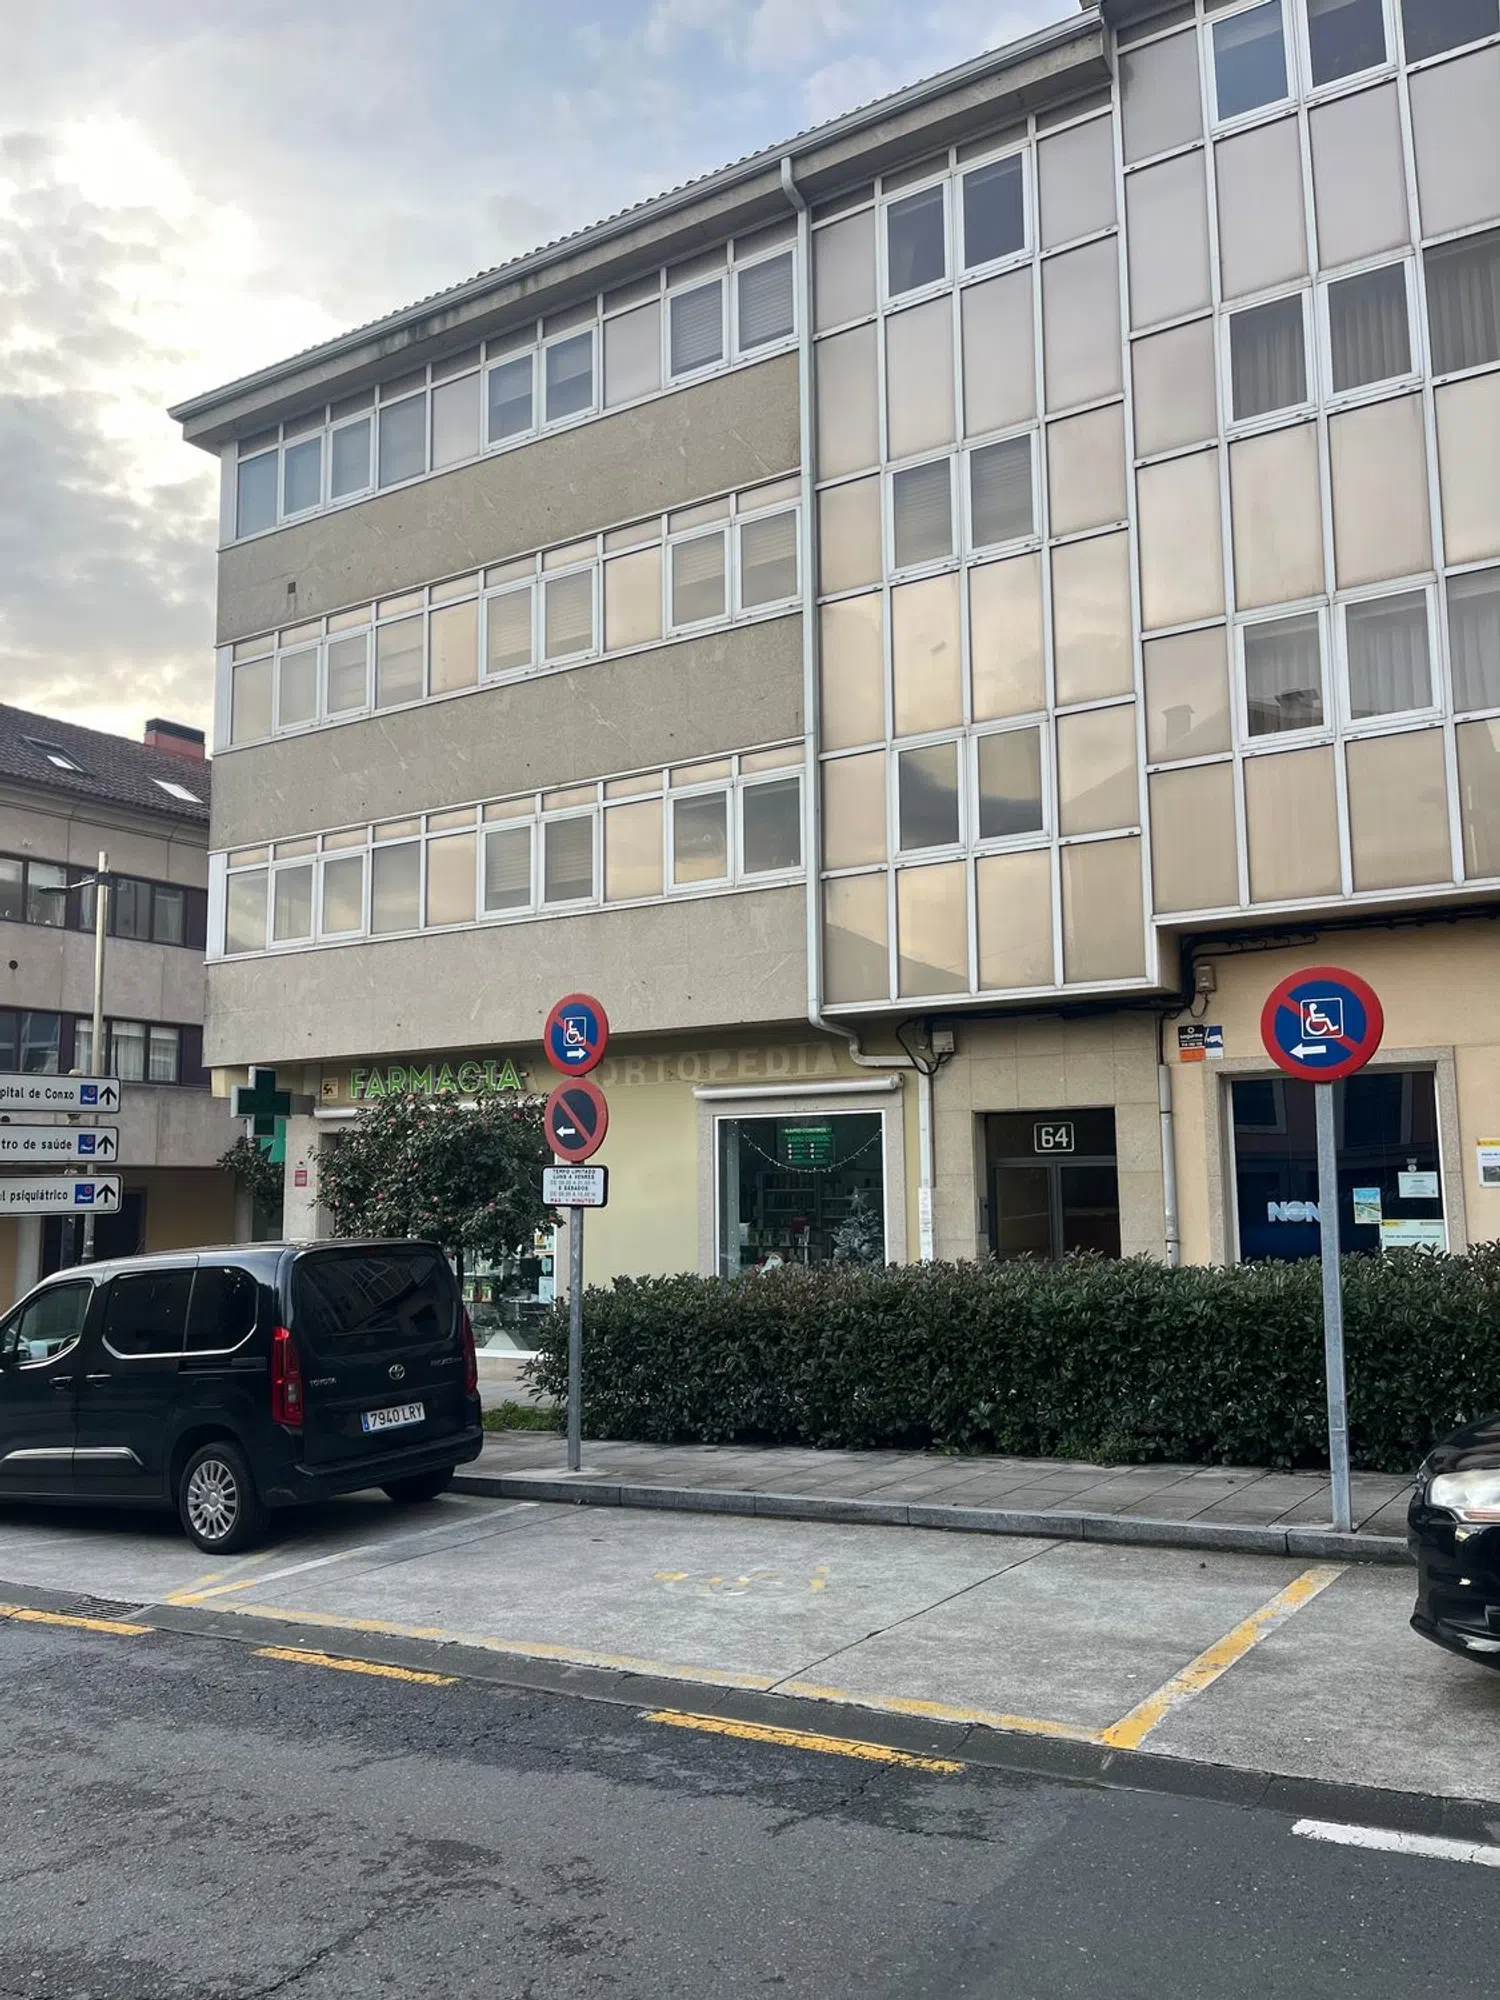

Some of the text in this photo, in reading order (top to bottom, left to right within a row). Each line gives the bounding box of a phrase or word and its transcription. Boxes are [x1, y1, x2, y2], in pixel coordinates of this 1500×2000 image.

[350, 1058, 523, 1099] FARMACIA
[28, 1088, 40, 1099] de
[45, 1088, 75, 1100] Conxo
[23, 1138, 36, 1149] de
[41, 1138, 72, 1149] saúde
[1041, 1126, 1069, 1148] 64
[10, 1190, 68, 1203] psiquiátrico
[310, 1377, 336, 1387] TOYOTA
[370, 1405, 423, 1428] 7940 LRY
